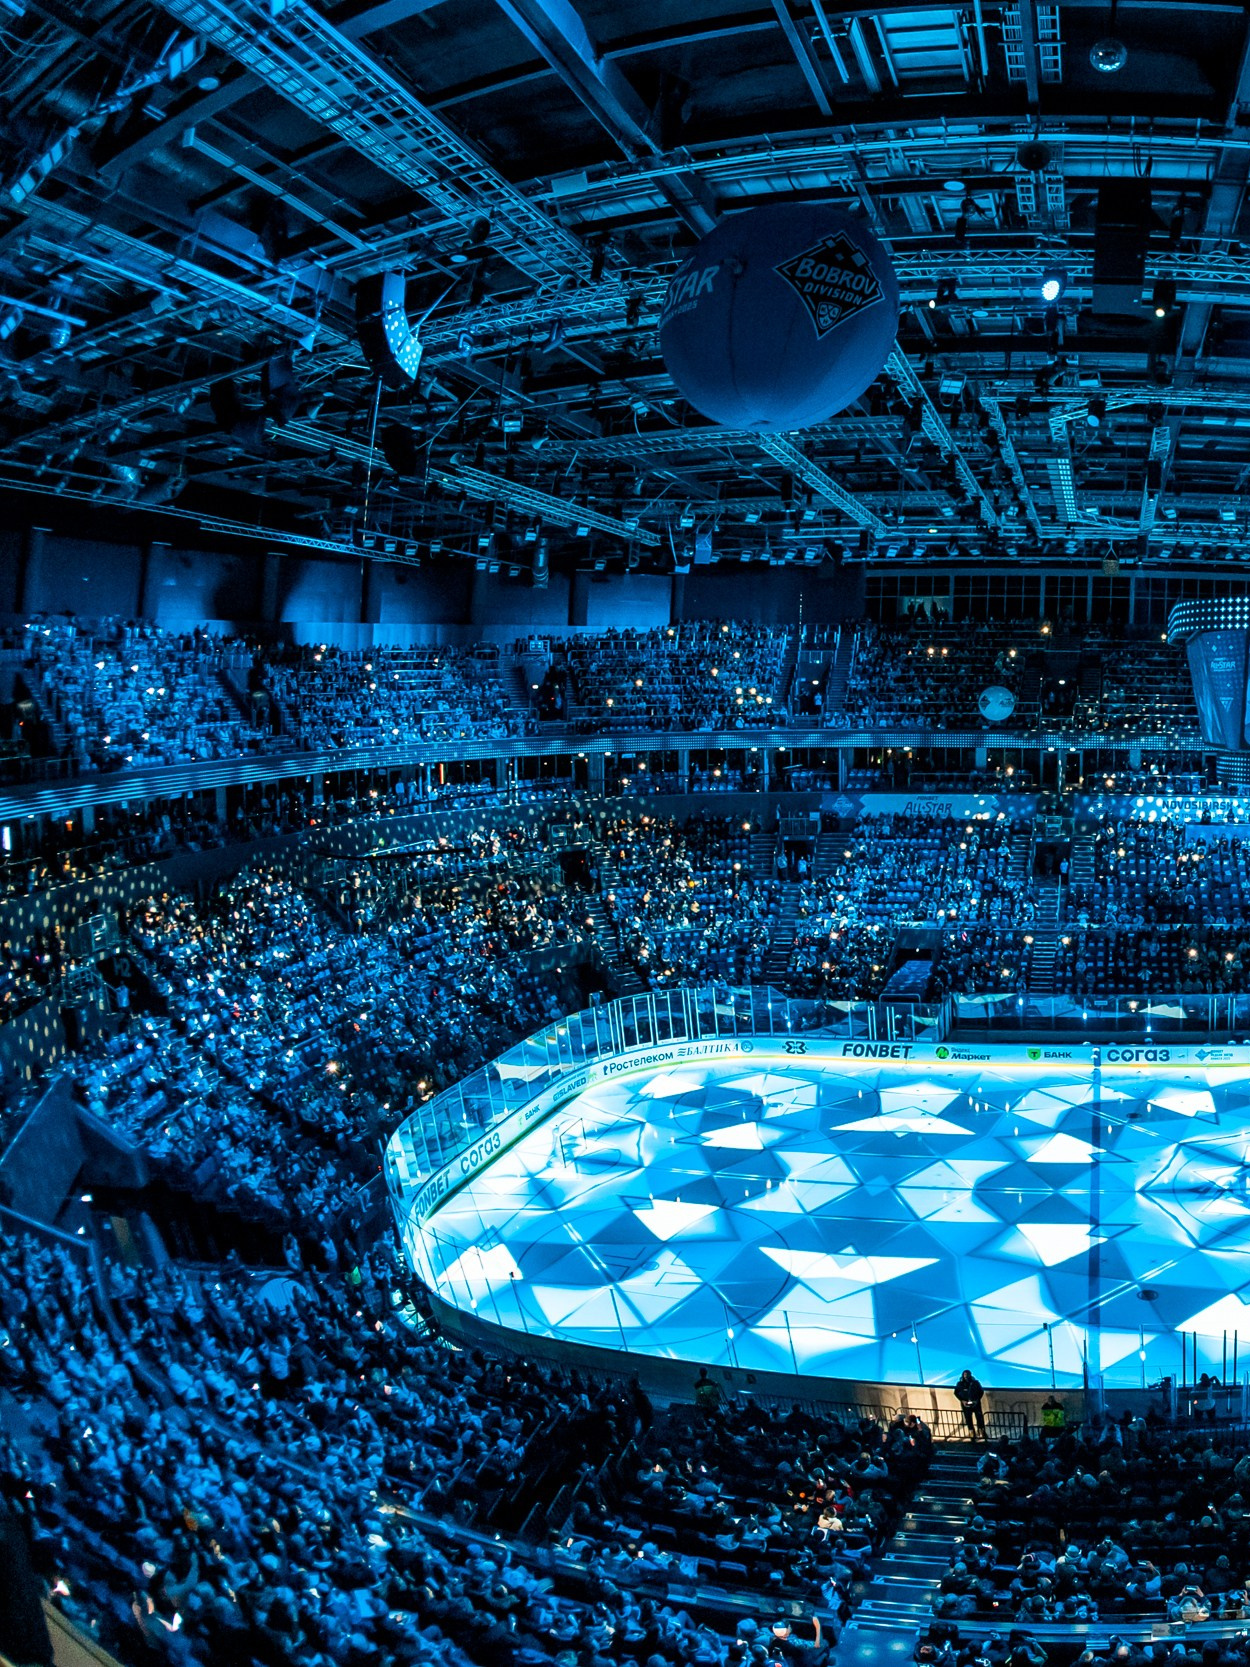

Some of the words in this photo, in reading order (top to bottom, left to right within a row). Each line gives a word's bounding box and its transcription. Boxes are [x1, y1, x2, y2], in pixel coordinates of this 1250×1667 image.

[797, 257, 876, 296] BOBROV
[803, 281, 863, 306] DIVISION
[1162, 800, 1233, 810] NOVOSIBIRSK
[686, 1042, 739, 1057] БАЛТИКА
[842, 1042, 912, 1059] FONBET
[951, 1053, 991, 1061] Маркет
[1044, 1051, 1072, 1059] БАНК
[609, 1051, 674, 1074] Ростелеком
[415, 1169, 451, 1218] FONBET
